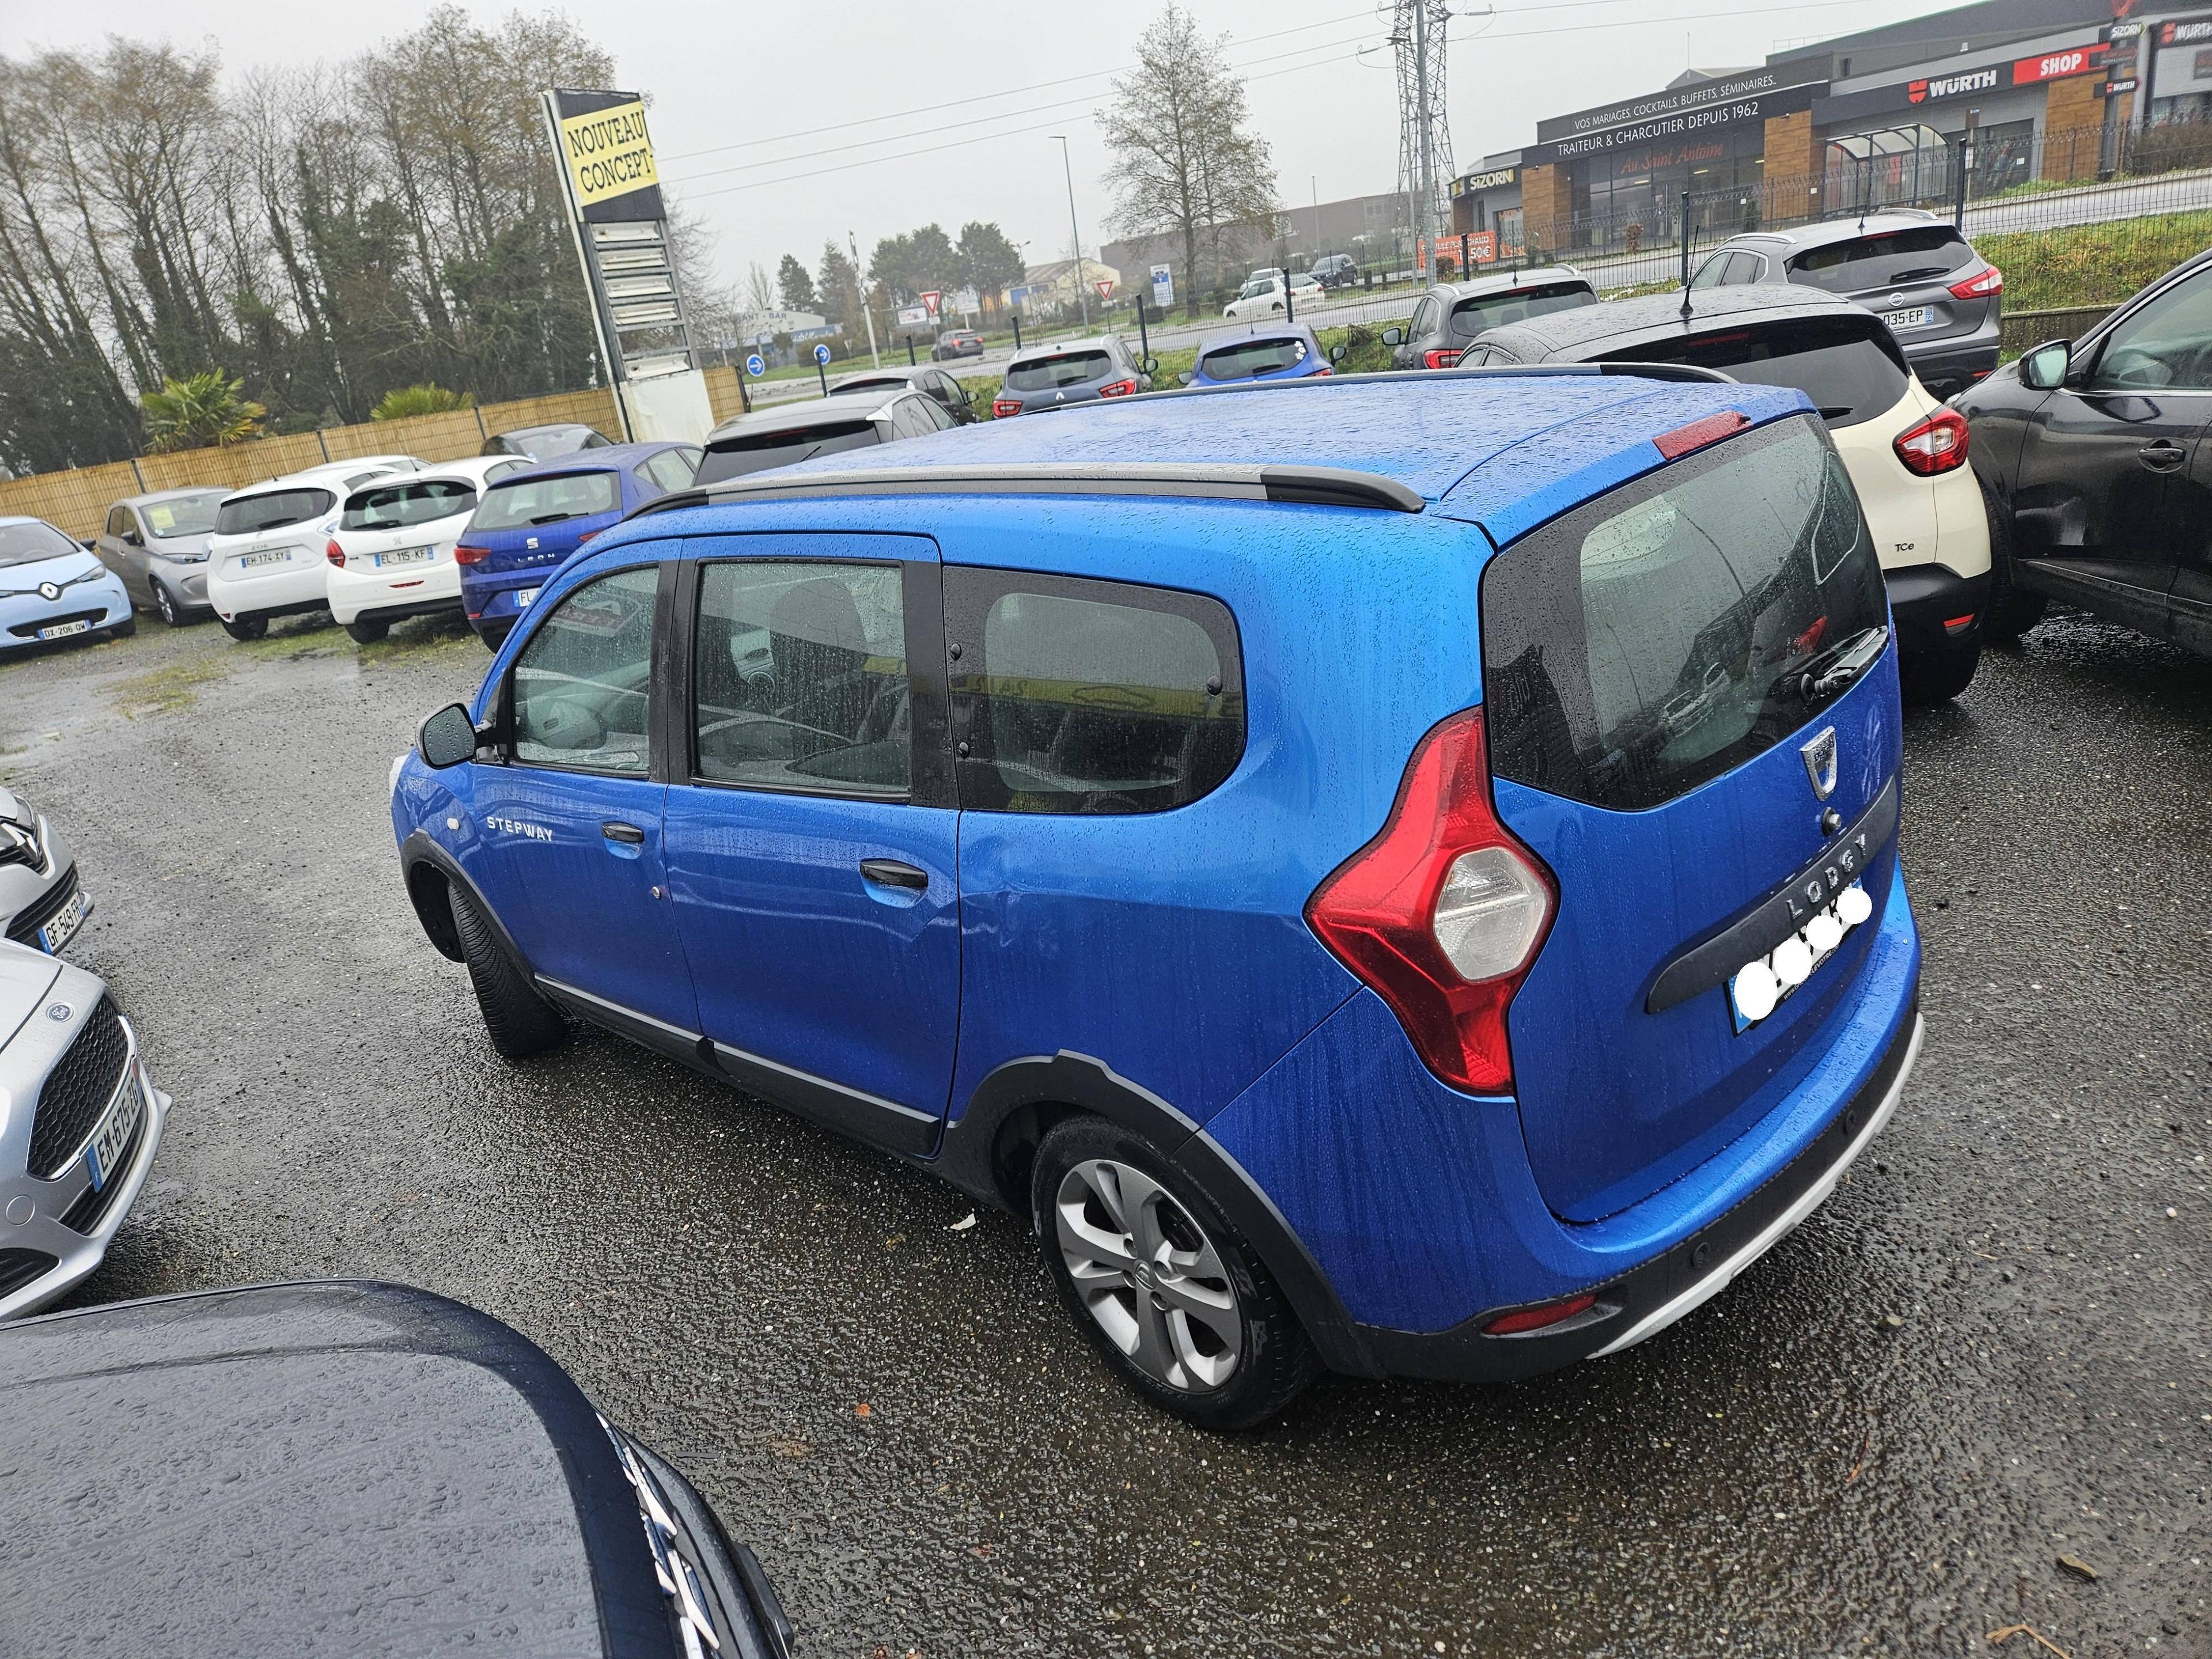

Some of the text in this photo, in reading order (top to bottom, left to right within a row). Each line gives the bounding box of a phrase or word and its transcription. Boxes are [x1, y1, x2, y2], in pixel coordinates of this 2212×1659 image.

[2040, 53, 2082, 77] SHOP
[1930, 70, 1997, 97] WÜRTH
[567, 111, 643, 158] NOUVEAU
[1558, 101, 1759, 156] TRAITEUR & CHARCUTIER DEPUIS 1962
[1575, 119, 1590, 130] VOS
[581, 147, 651, 194] CONCEPT
[1642, 150, 1672, 170] Saint
[1895, 543, 1914, 552] TCe
[487, 816, 552, 842] STEPWAY
[1786, 834, 1866, 920] LODGY
